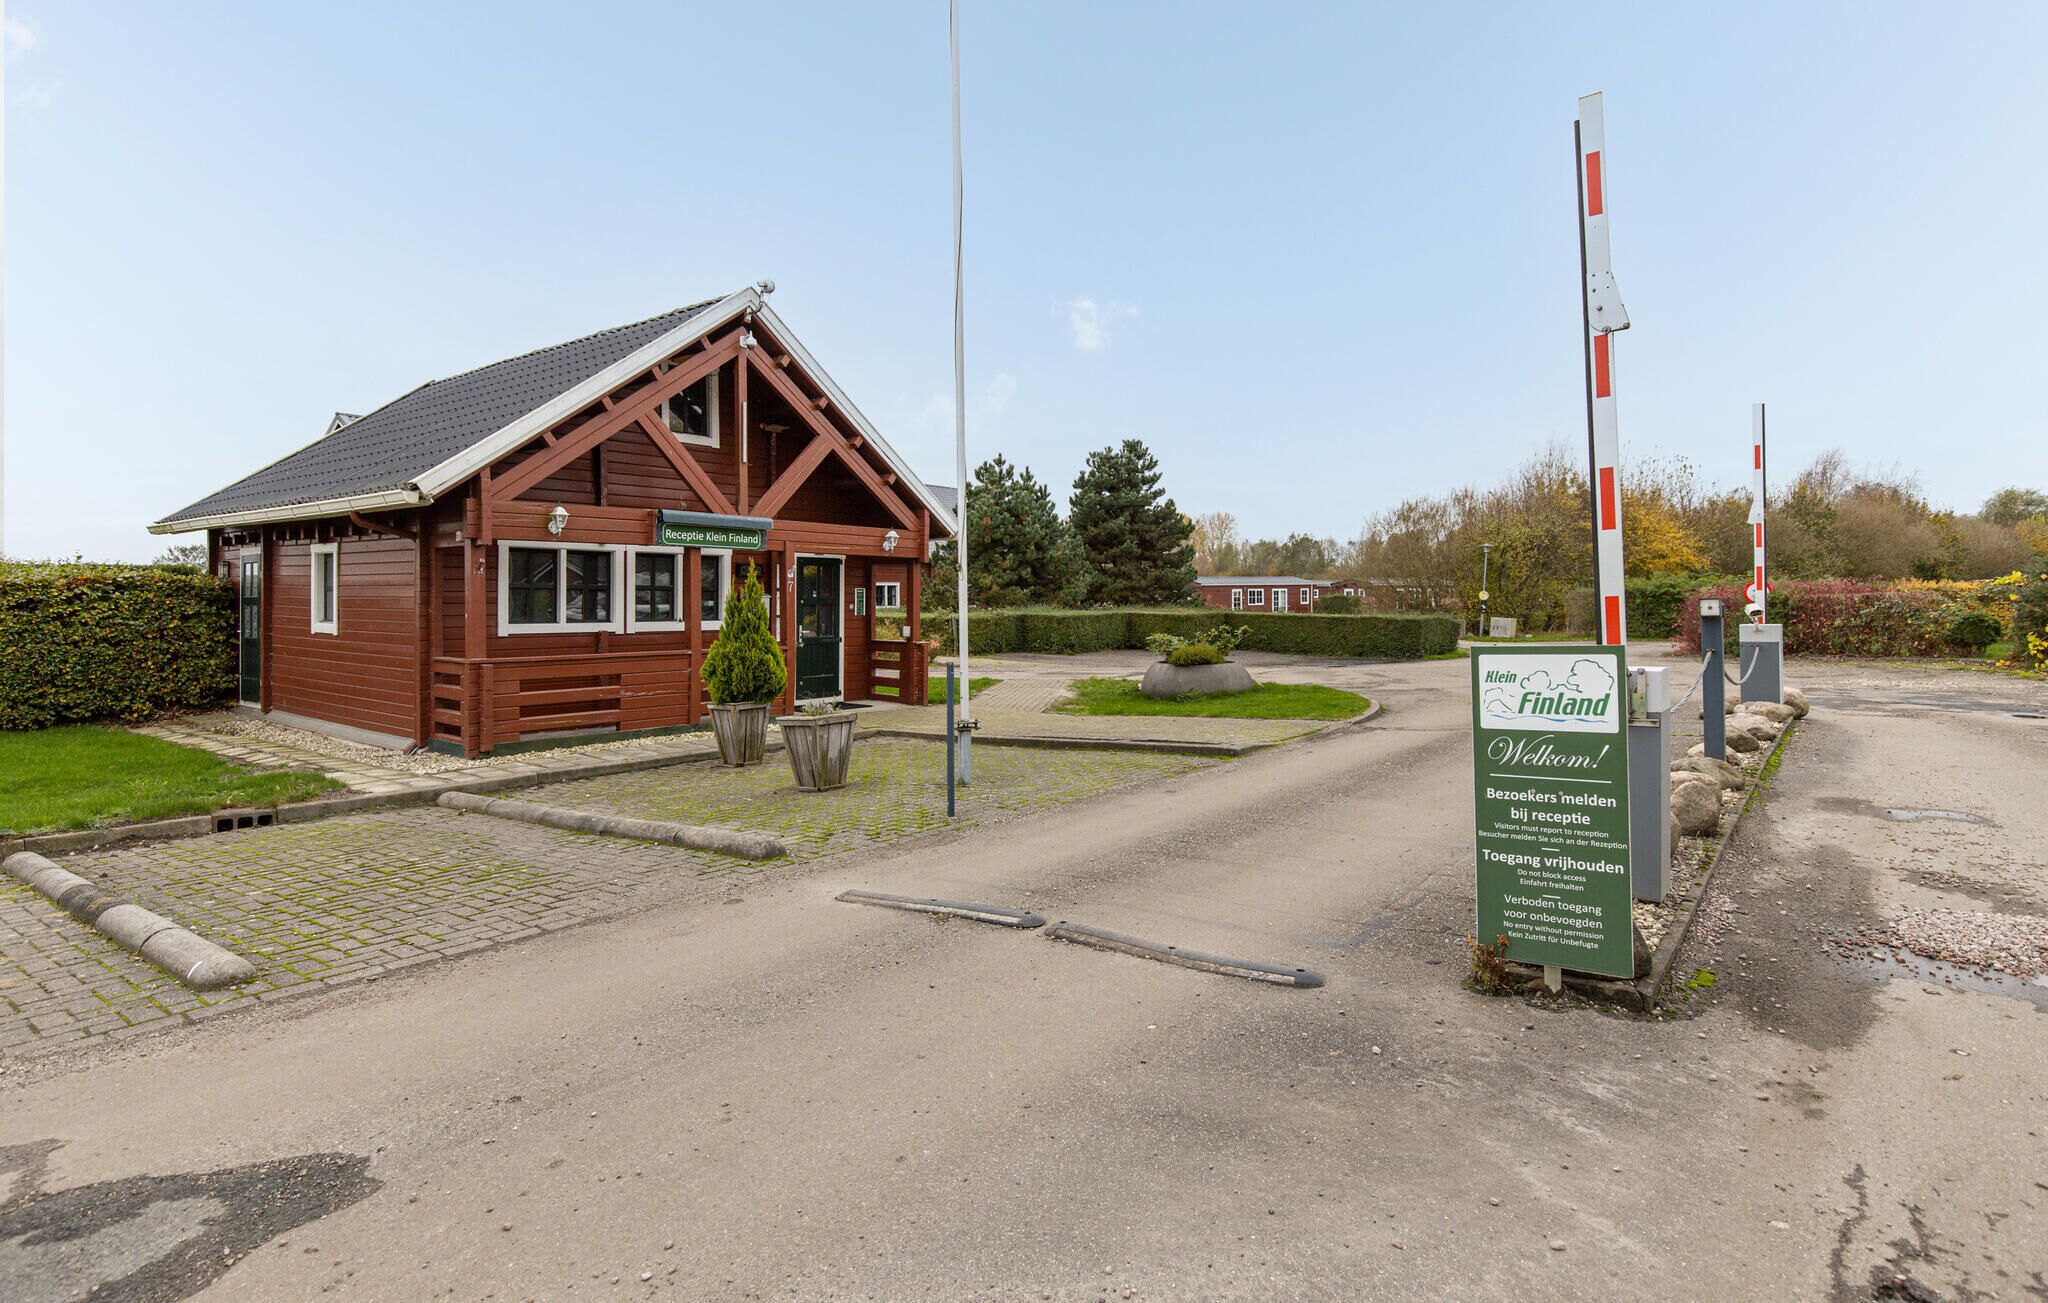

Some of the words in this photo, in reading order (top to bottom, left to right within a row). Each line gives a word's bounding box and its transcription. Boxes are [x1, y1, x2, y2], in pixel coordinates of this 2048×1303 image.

[665, 529, 704, 541] Receptie
[706, 532, 727, 542] Klein
[729, 534, 758, 544] Finland
[788, 582, 793, 592] 7
[1485, 671, 1516, 683] Klein
[1518, 692, 1610, 716] Finland
[1488, 735, 1609, 768] Welkom!
[1487, 788, 1557, 803] Bezoekers
[1561, 794, 1616, 807] melden
[1511, 808, 1528, 821] bij
[1532, 812, 1590, 824] receptie
[1574, 830, 1609, 838] reception
[1591, 841, 1627, 849] Rezeption
[1483, 849, 1540, 867] Toegang
[1544, 857, 1624, 874] vrijhouden
[1520, 878, 1547, 887] Einfahrt
[1549, 882, 1584, 891] freihalten
[1504, 894, 1555, 908] Verboden
[1558, 900, 1602, 916] toegang
[1504, 909, 1527, 918] voor
[1530, 913, 1602, 929] onbevoegden
[1535, 925, 1562, 934] without
[1564, 929, 1604, 940] permission
[1525, 933, 1546, 941] Zutritt
[1560, 937, 1598, 949] Unbefugte
